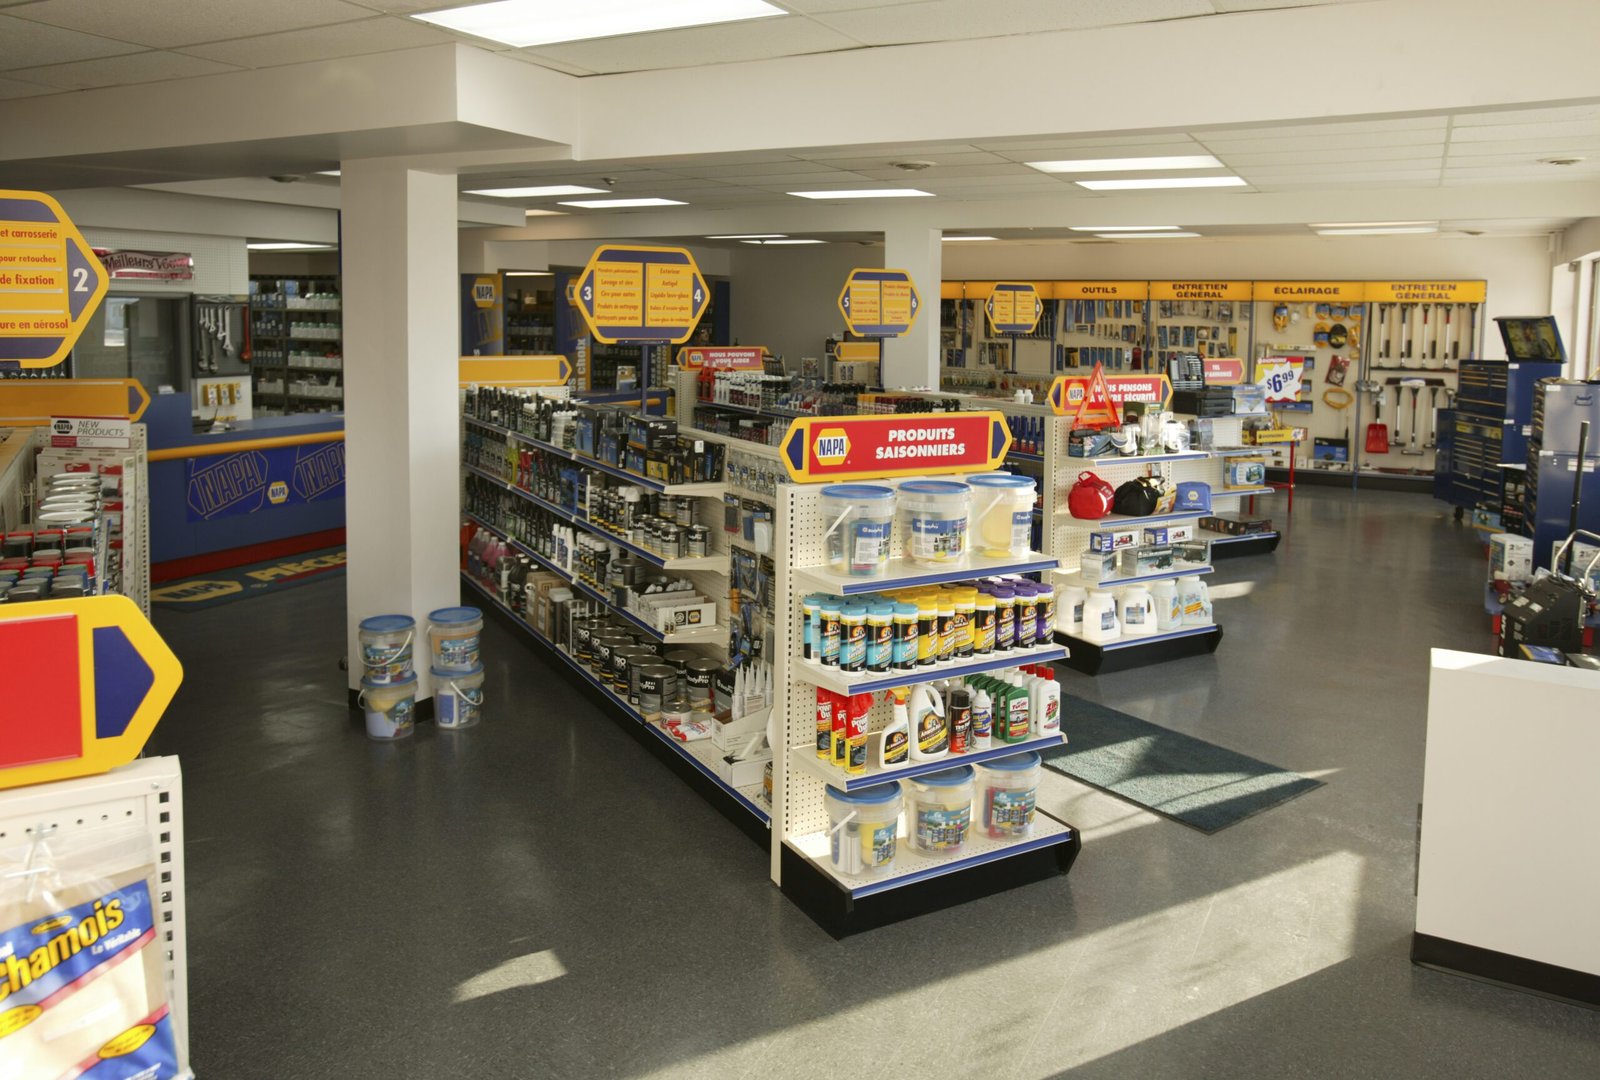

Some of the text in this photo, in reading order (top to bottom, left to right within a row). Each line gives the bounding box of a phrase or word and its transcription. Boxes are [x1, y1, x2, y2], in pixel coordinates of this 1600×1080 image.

[11, 229, 58, 239] carrosserie
[19, 255, 57, 263] retouches
[15, 274, 55, 285] fixation
[72, 268, 89, 292] 2
[1391, 283, 1457, 291] ENTRETIEN
[583, 286, 592, 300] 3
[693, 289, 702, 302] 4
[844, 297, 850, 307] 5
[911, 298, 917, 308] 6
[19, 320, 31, 329] en
[33, 319, 69, 329] aérosol
[1095, 383, 1152, 392] NUS PENSONS
[1098, 393, 1122, 402] VTRE
[1124, 391, 1156, 402] SÉCURITÉ
[77, 427, 124, 436] PRODUCTS
[888, 428, 955, 442] PRODUITS
[818, 437, 846, 457] NAPA
[875, 443, 966, 460] SAISONNIERS
[270, 486, 287, 498] NAPA
